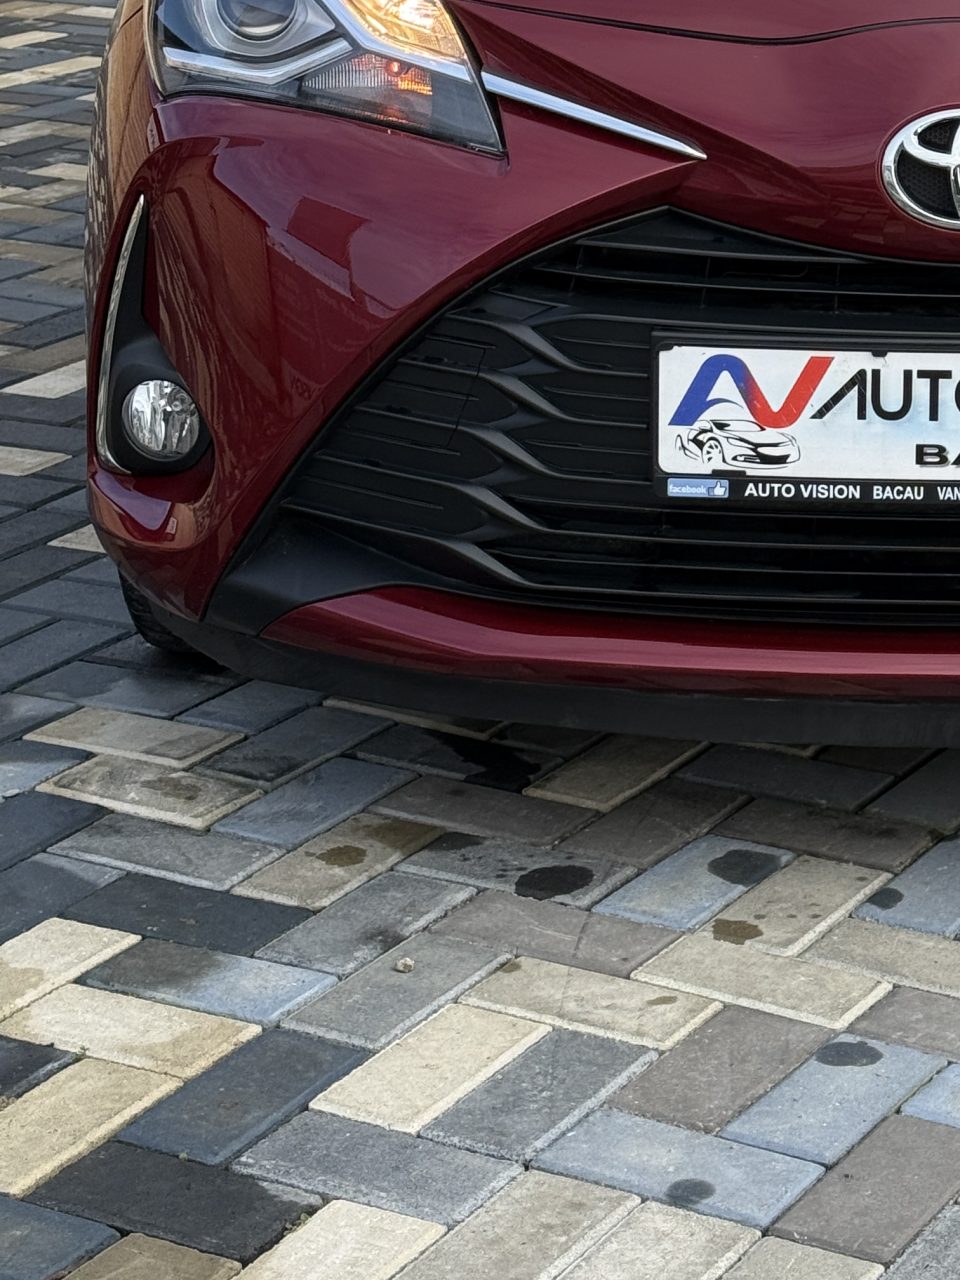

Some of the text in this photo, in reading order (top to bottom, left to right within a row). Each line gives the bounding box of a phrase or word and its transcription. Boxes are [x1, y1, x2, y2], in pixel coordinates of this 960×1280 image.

[669, 484, 707, 494] facebook
[744, 482, 796, 498] AUTO
[800, 483, 861, 499] VISION
[872, 485, 924, 501] BACAU
